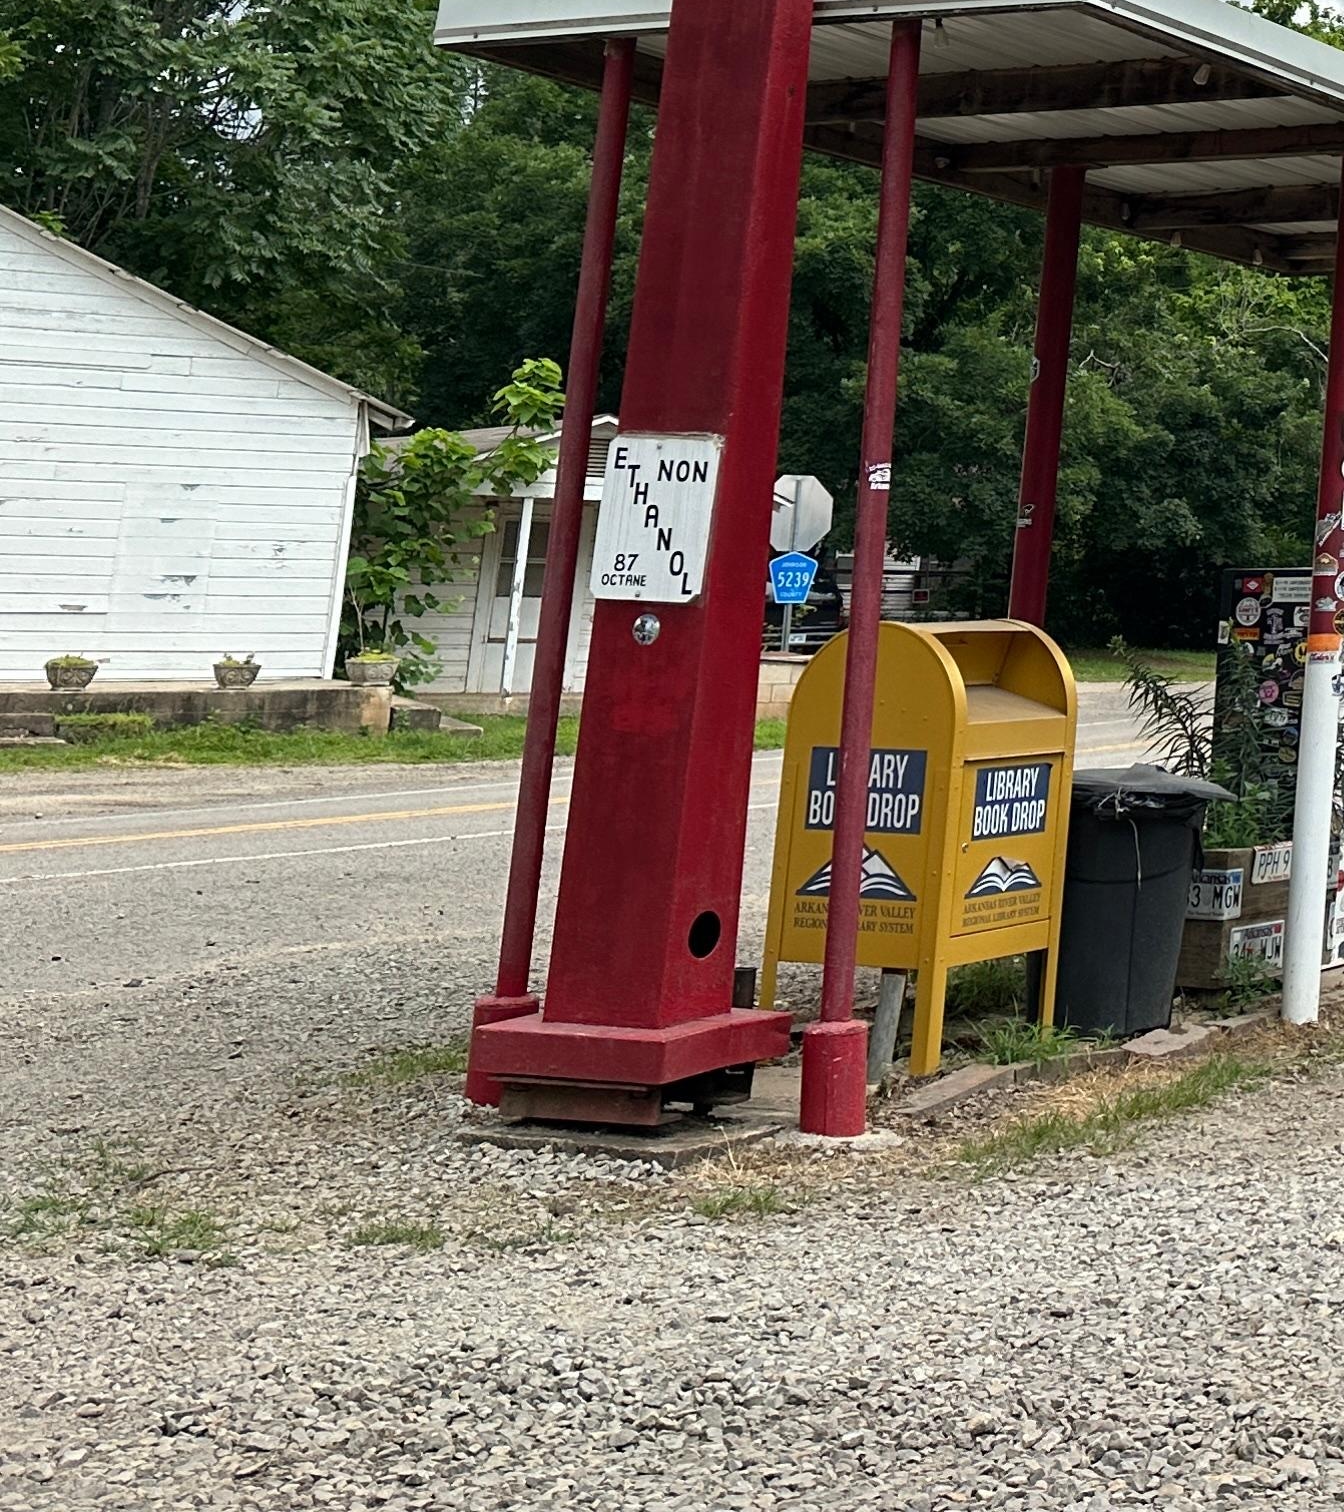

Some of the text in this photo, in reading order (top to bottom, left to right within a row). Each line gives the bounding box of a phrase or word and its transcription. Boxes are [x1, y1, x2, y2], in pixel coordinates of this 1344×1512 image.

[657, 459, 709, 483] NON
[614, 553, 640, 571] 87
[601, 573, 647, 587] OCTANE
[777, 571, 810, 588] 5239
[827, 751, 910, 789] LARY
[985, 767, 1039, 802] LIBRARY
[866, 792, 920, 829] DROP
[974, 799, 1046, 836] BOOK DROP
[794, 901, 829, 915] ARKAN
[880, 905, 916, 919] VALLEY
[793, 917, 828, 929] REGION
[879, 922, 914, 934] SYSTEM
